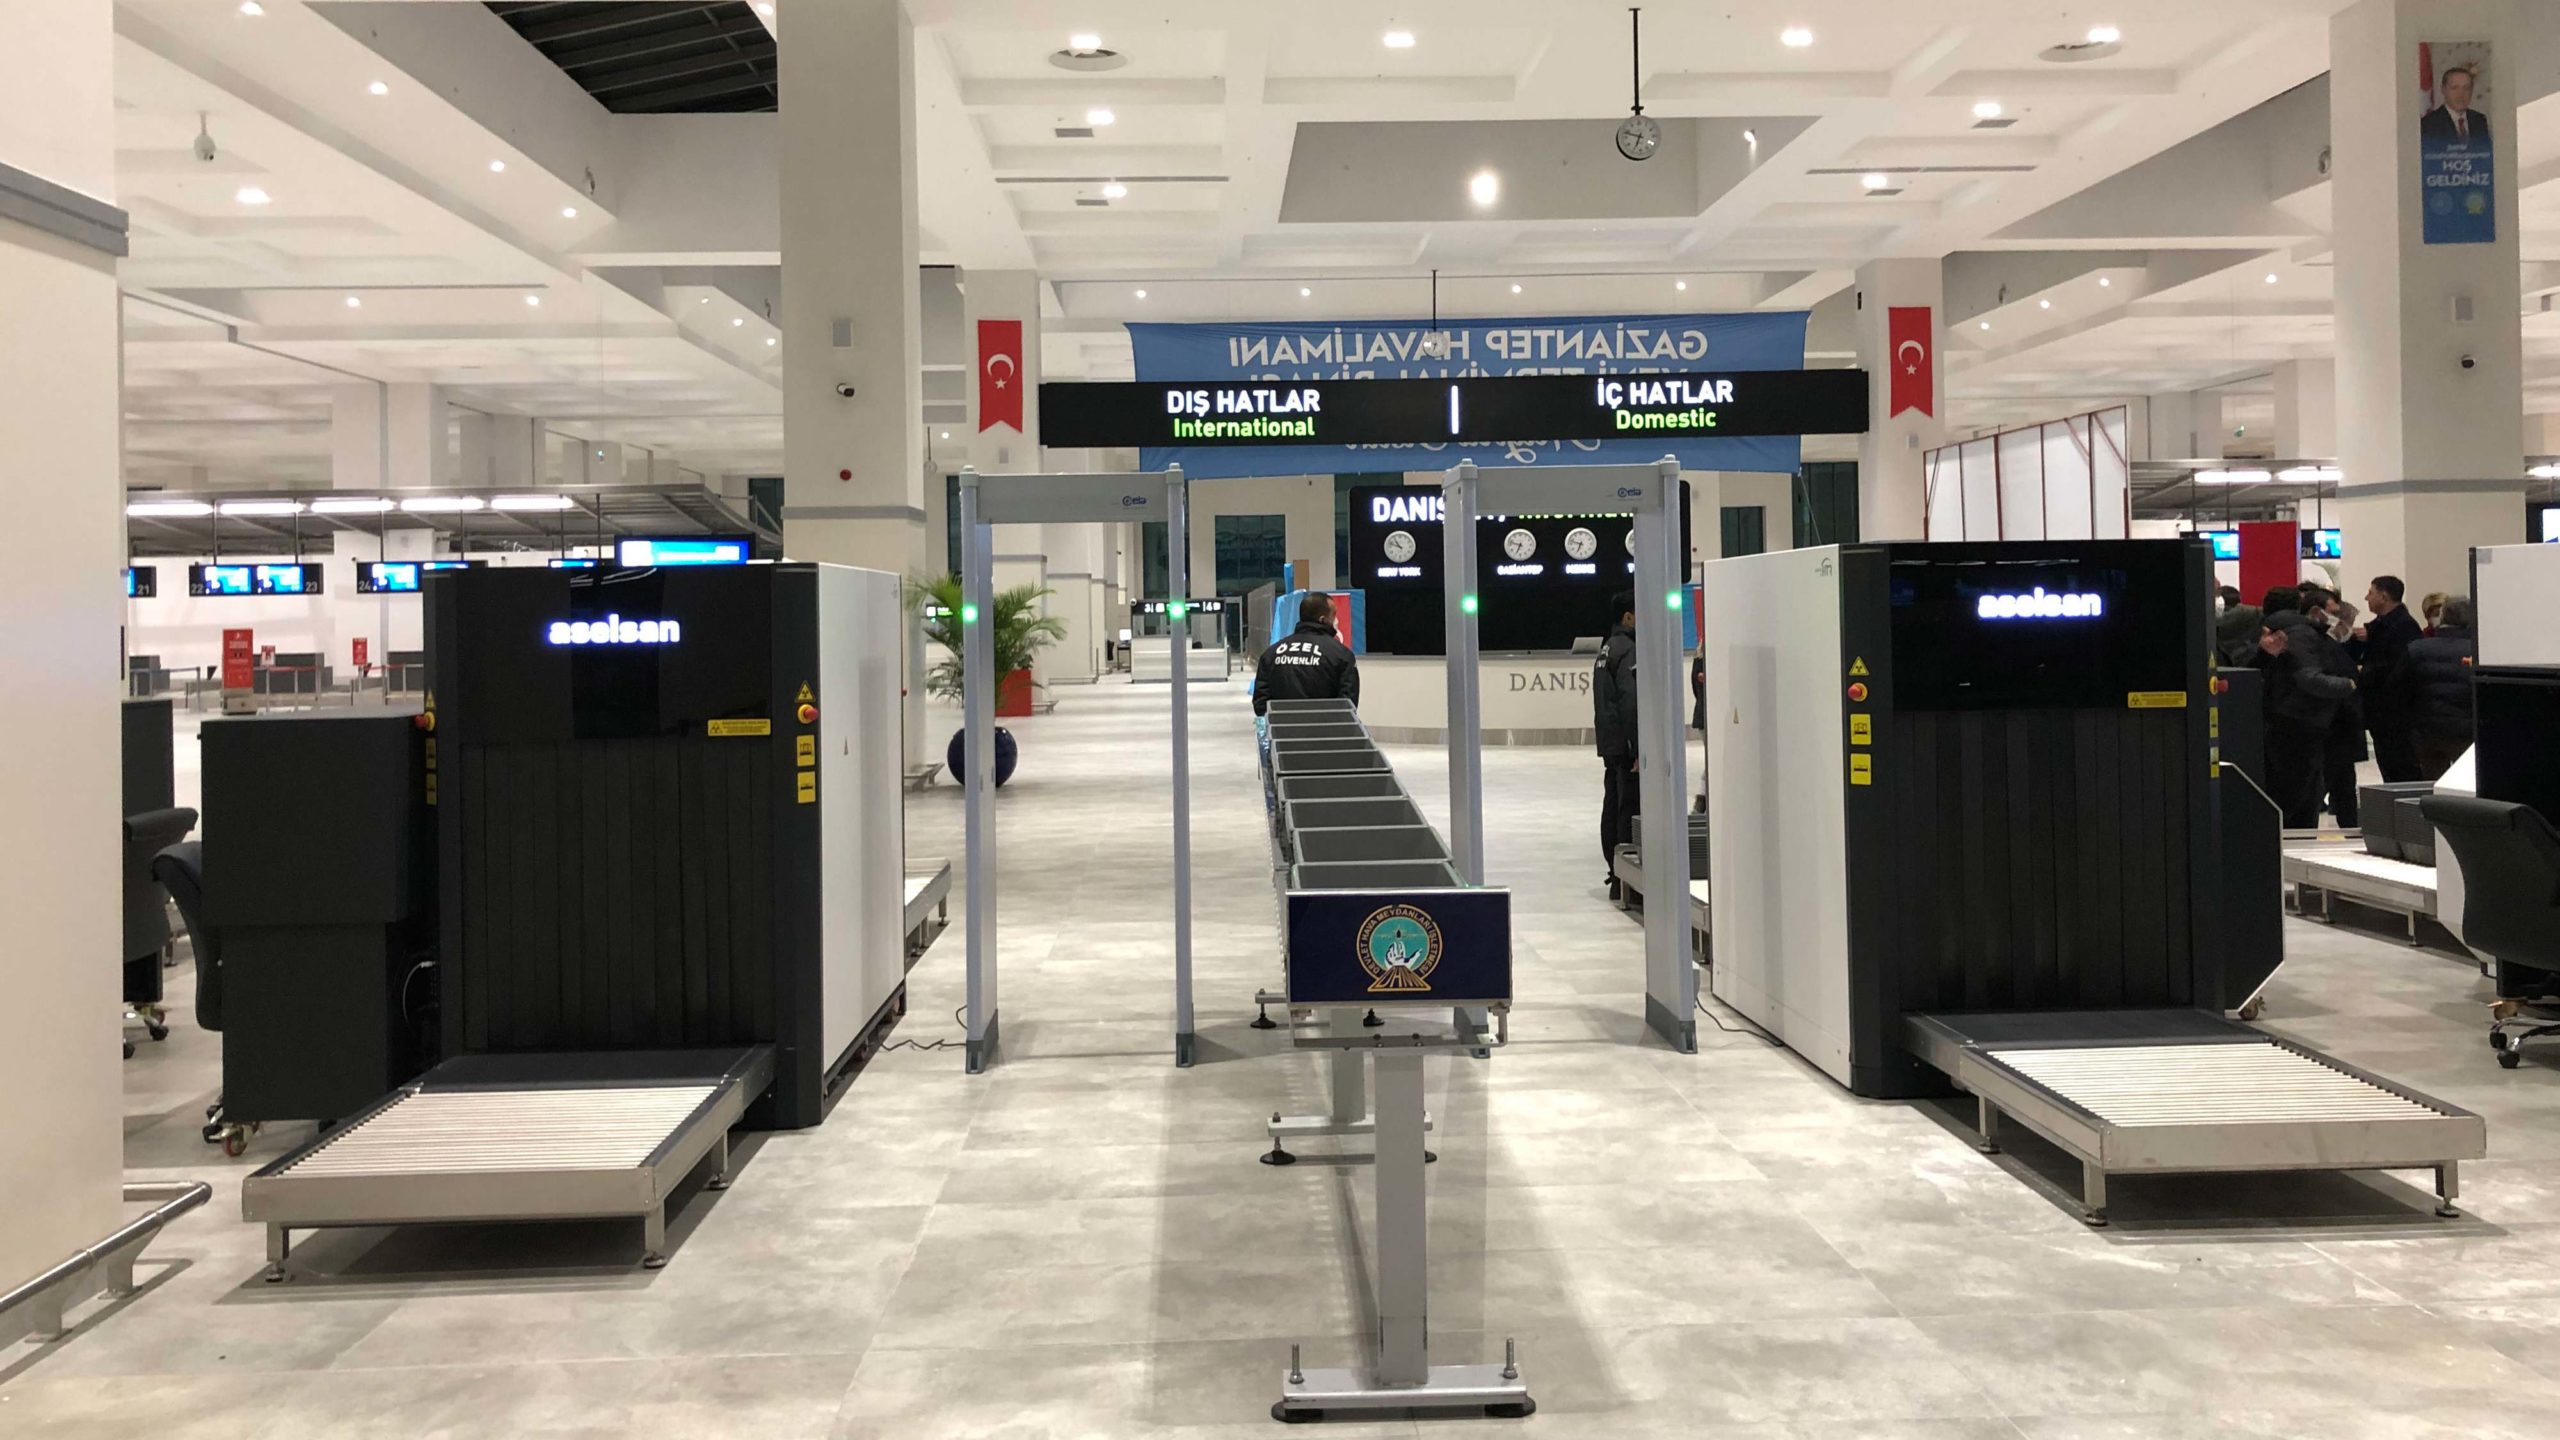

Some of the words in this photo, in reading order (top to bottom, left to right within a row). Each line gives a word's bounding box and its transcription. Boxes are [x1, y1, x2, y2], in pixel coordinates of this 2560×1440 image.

[1167, 390, 1211, 417] DIŞ
[1217, 389, 1321, 414] HATLAR
[1597, 378, 1623, 409] İÇ
[1630, 380, 1734, 405] HATLAR
[1173, 416, 1316, 438] International
[1616, 408, 1717, 430] Domestic
[358, 580, 371, 591] 24
[549, 613, 680, 644] aselsan
[1274, 654, 1321, 666] GÜVENLİK
[1275, 642, 1323, 657] ÖZEL
[1361, 919, 1379, 941] HAVA
[1376, 907, 1433, 931] MEYDANLARI
[1360, 942, 1381, 975] DEVLET
